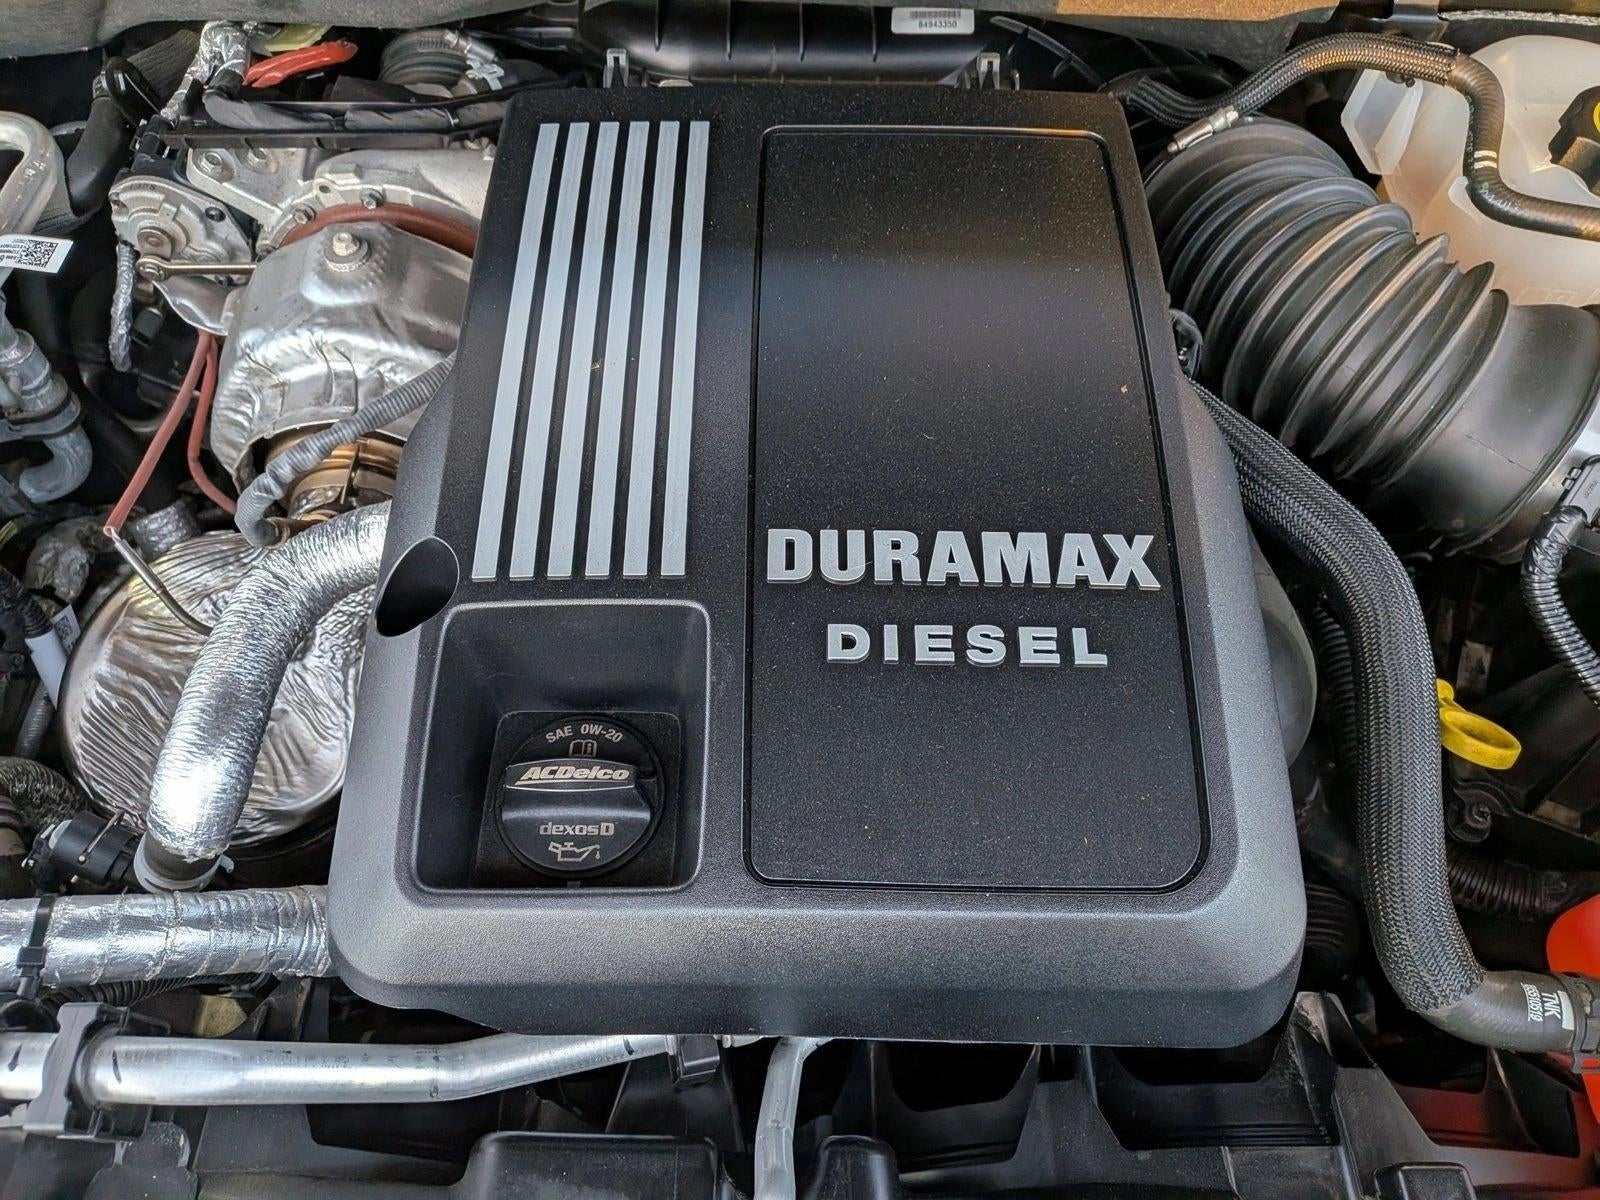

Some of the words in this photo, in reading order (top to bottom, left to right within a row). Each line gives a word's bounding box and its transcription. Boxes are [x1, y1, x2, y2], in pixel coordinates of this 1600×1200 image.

[767, 528, 1161, 591] DURAMAX
[826, 623, 1108, 668] DIESEL
[545, 725, 573, 743] SAE
[580, 723, 624, 743] 0W-20
[520, 766, 630, 780] ACDelco
[1541, 992, 1561, 1020] TNK
